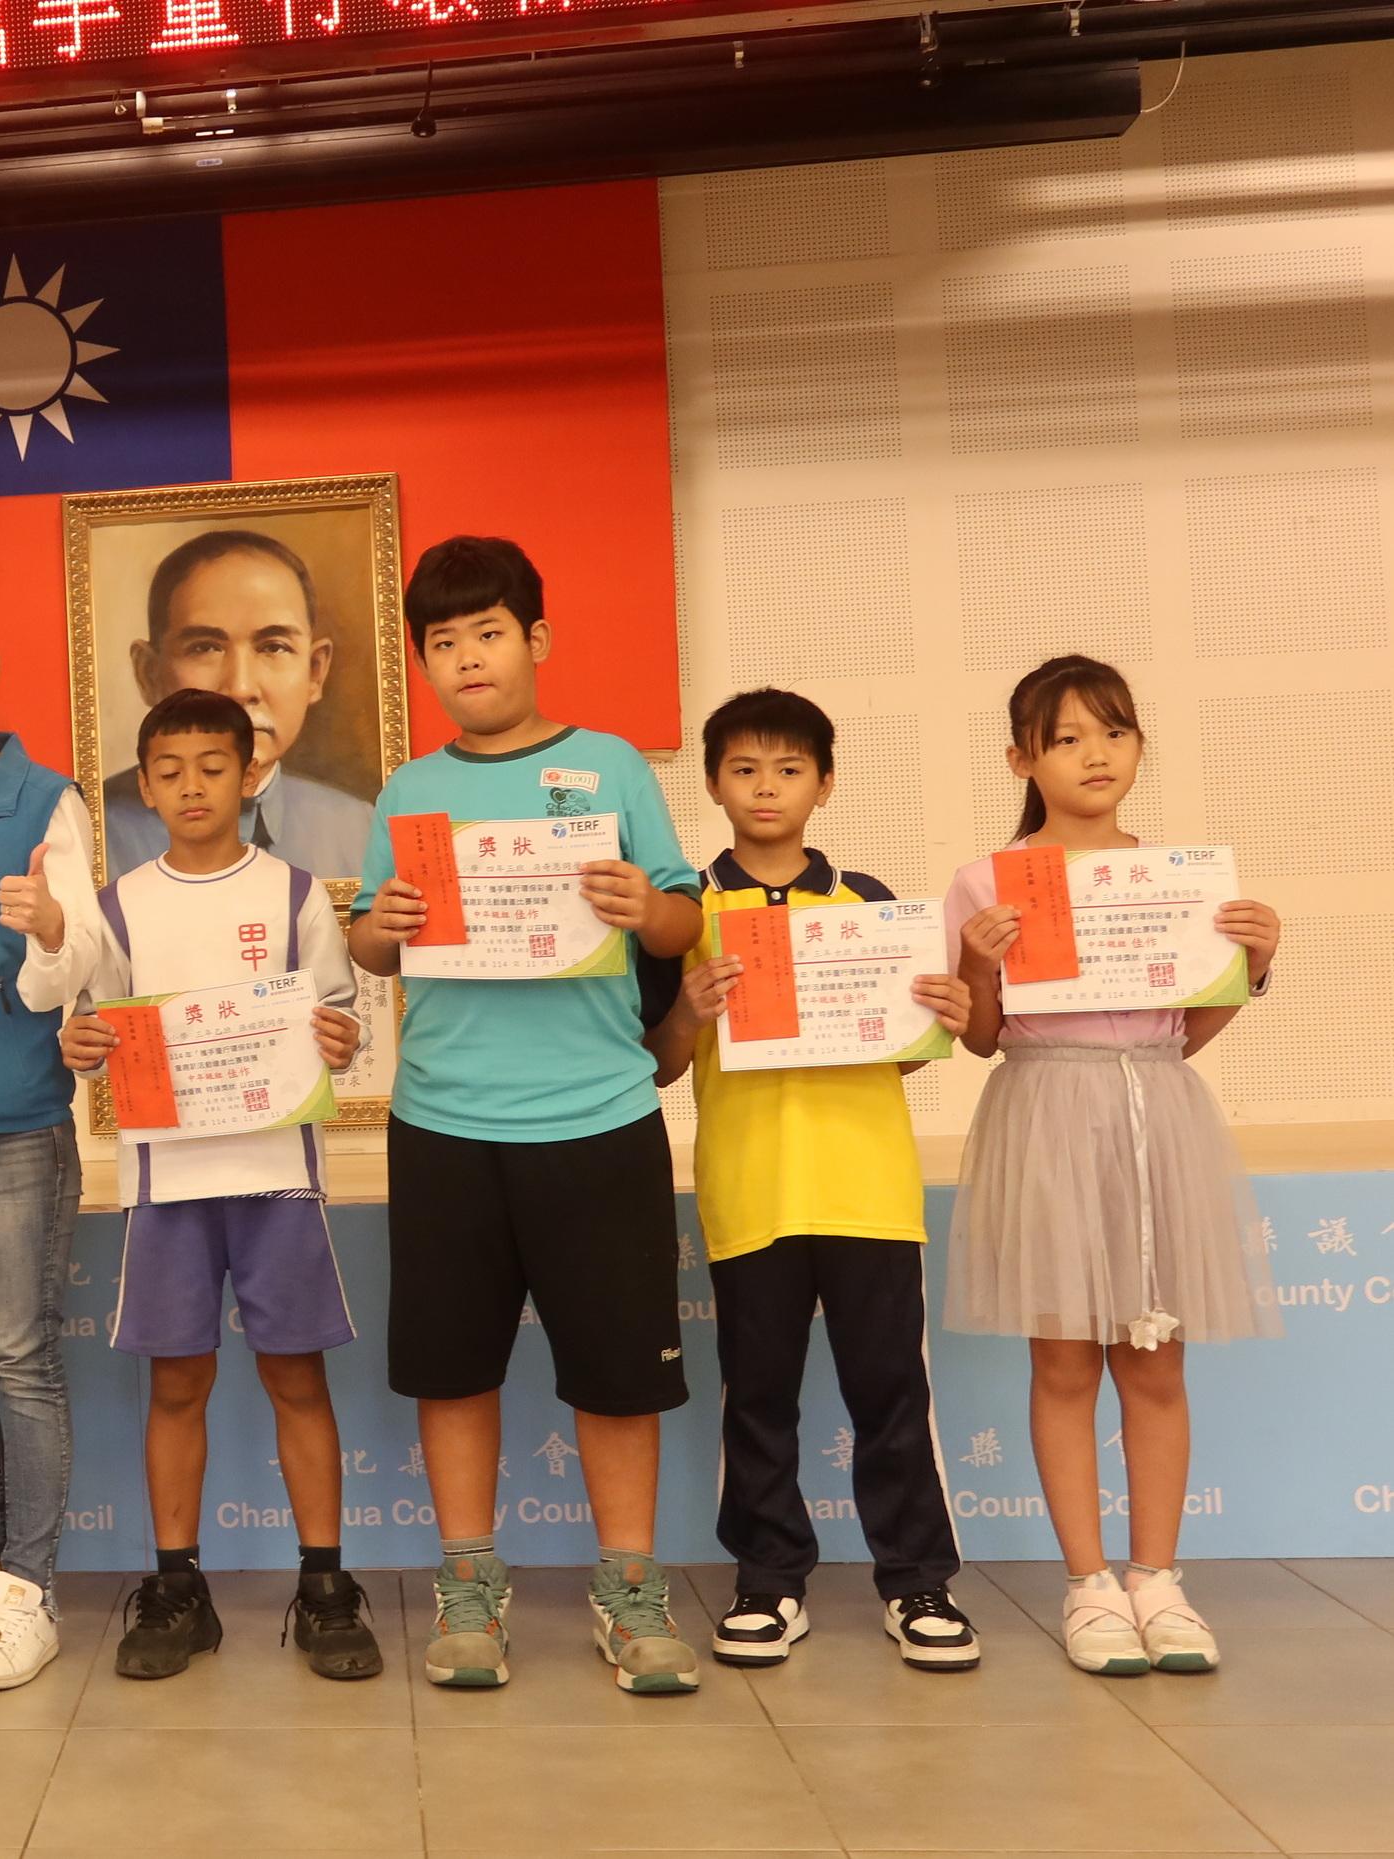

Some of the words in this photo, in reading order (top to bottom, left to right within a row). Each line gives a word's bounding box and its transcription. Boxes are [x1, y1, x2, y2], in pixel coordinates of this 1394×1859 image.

[570, 820, 600, 832] TERF
[478, 836, 535, 857] 獎狀
[1186, 850, 1216, 861] TERF
[1093, 864, 1153, 887] 獎狀
[515, 909, 539, 920] 佳作
[896, 904, 927, 915] TERF
[805, 920, 863, 943] 獎狀
[268, 977, 297, 992] TERF
[184, 1000, 241, 1025] 獎狀
